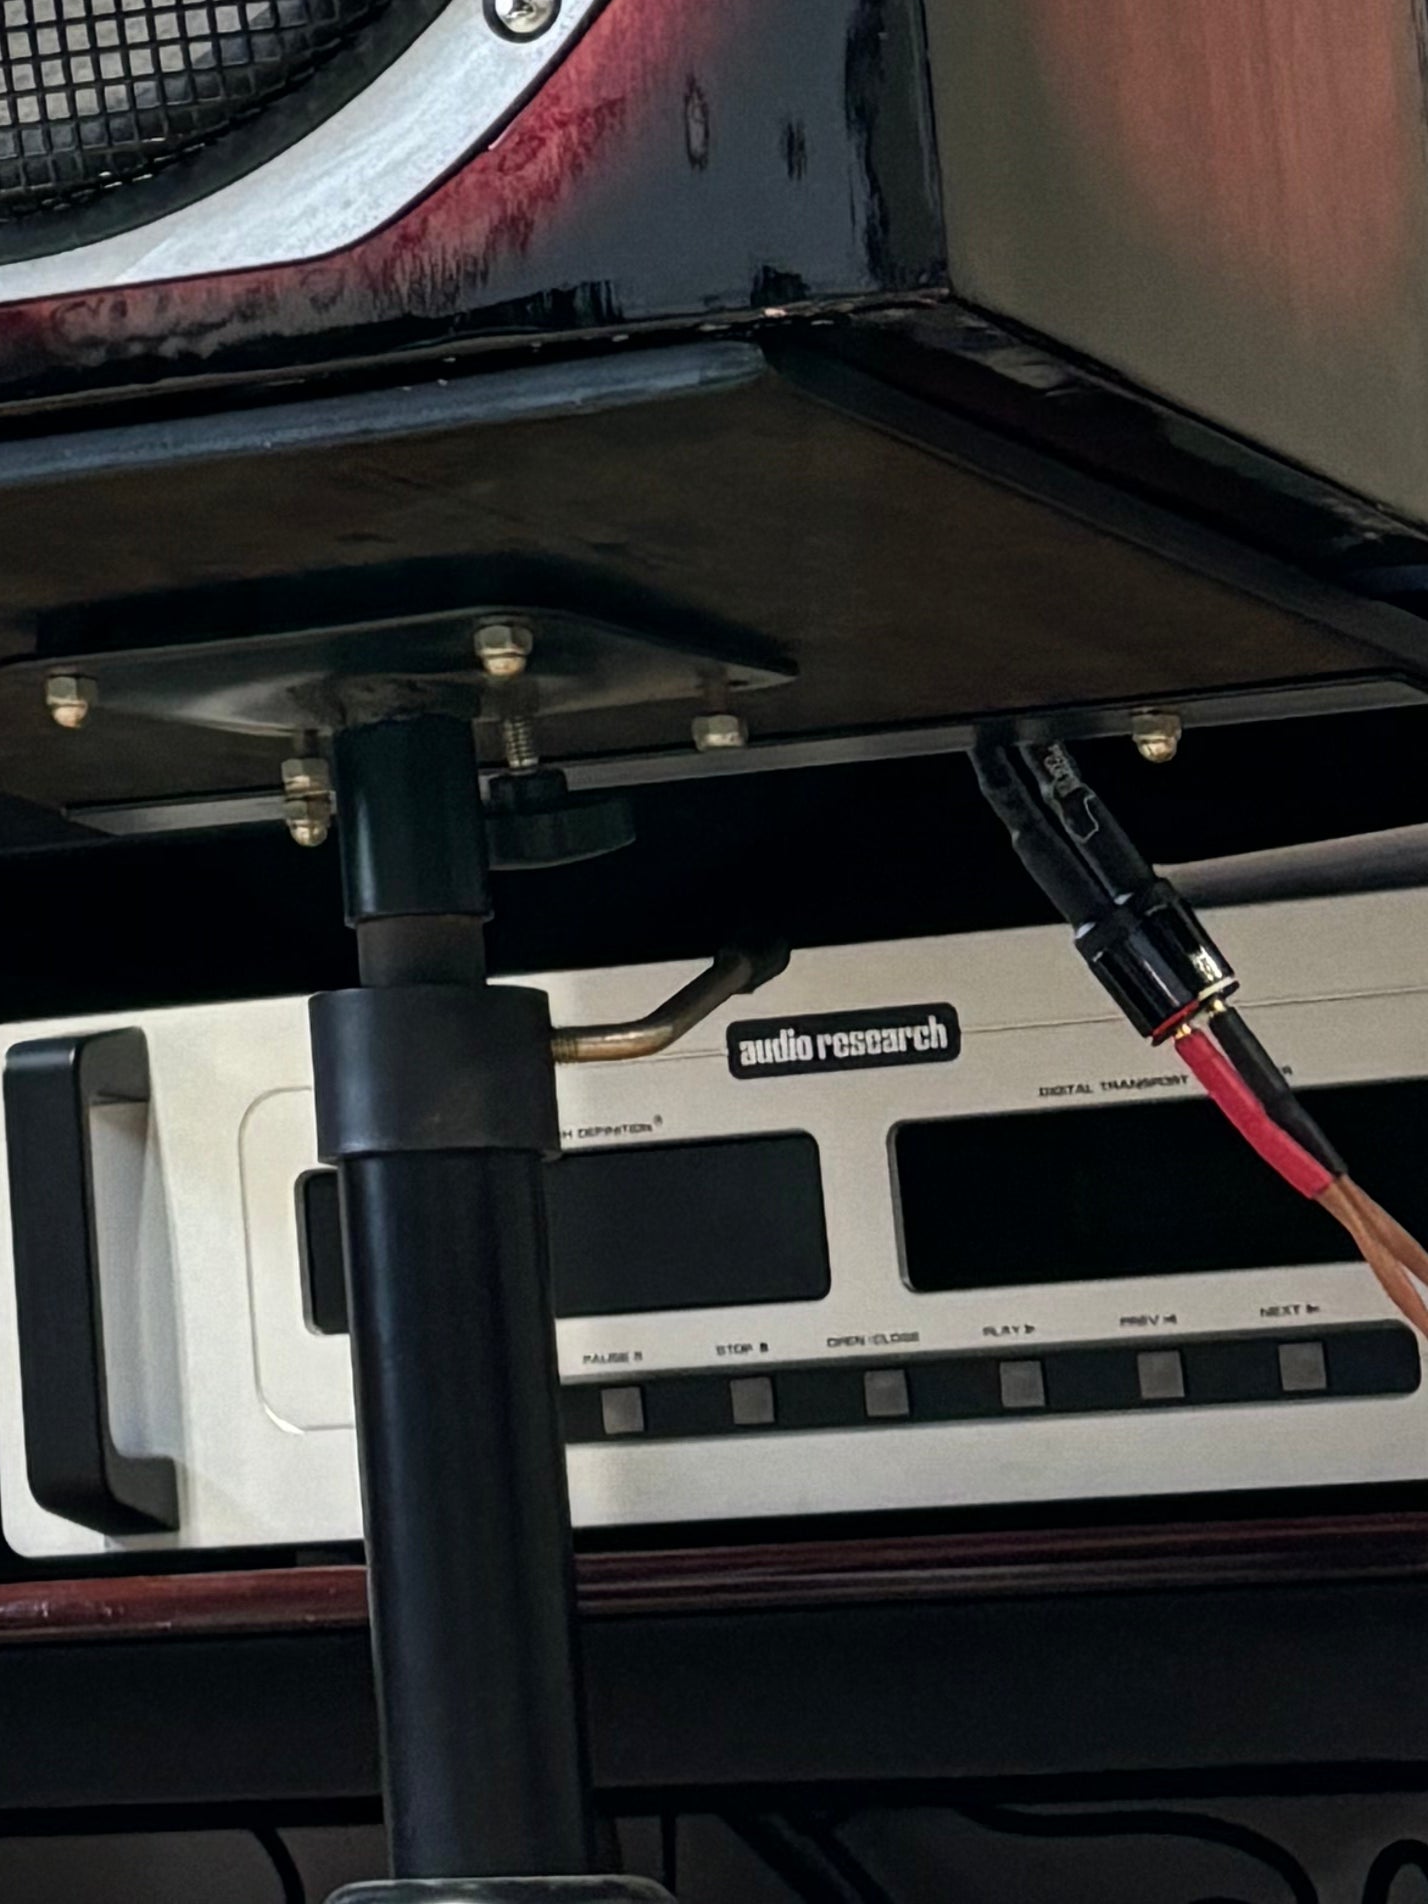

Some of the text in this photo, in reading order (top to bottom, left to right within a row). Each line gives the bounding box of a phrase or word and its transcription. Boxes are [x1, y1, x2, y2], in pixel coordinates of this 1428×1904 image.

[739, 1015, 948, 1067] audio research
[1260, 1303, 1300, 1318] NEXT
